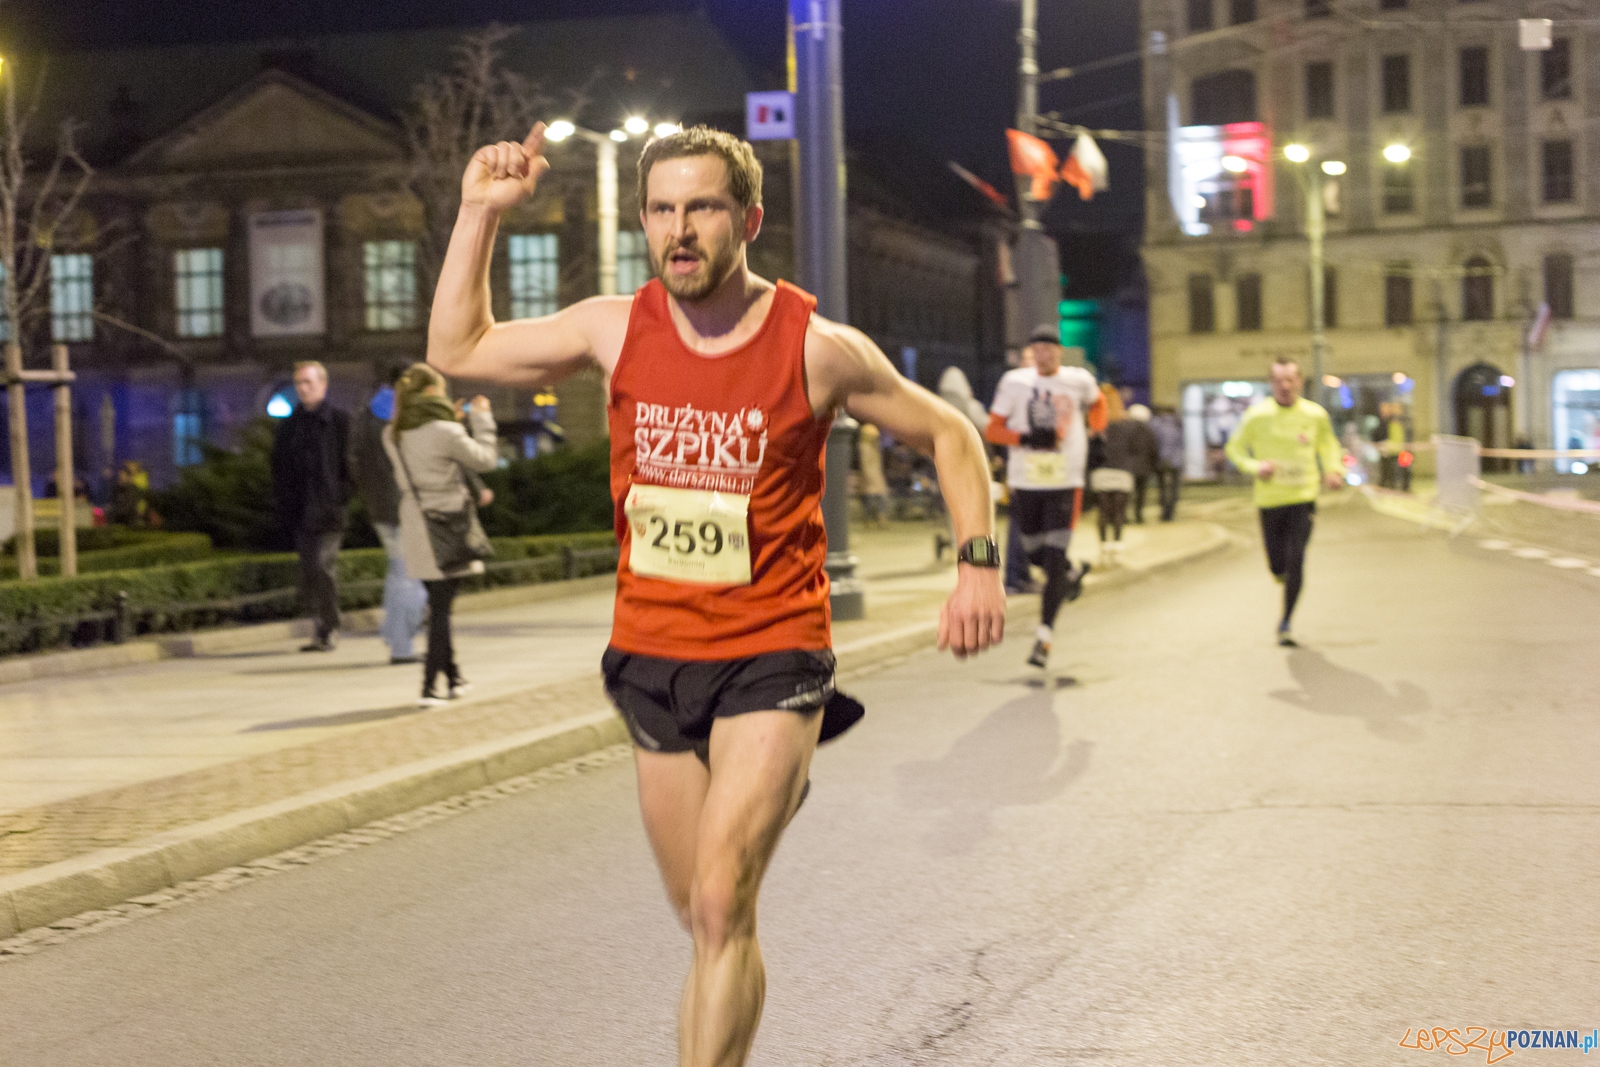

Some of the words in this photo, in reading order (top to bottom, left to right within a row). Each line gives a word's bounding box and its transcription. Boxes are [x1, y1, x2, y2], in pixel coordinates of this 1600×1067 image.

[635, 401, 745, 438] DRUŻYNA
[634, 427, 768, 469] SZPIKU
[638, 464, 755, 495] www.darszpiku.pl
[650, 516, 724, 557] 259
